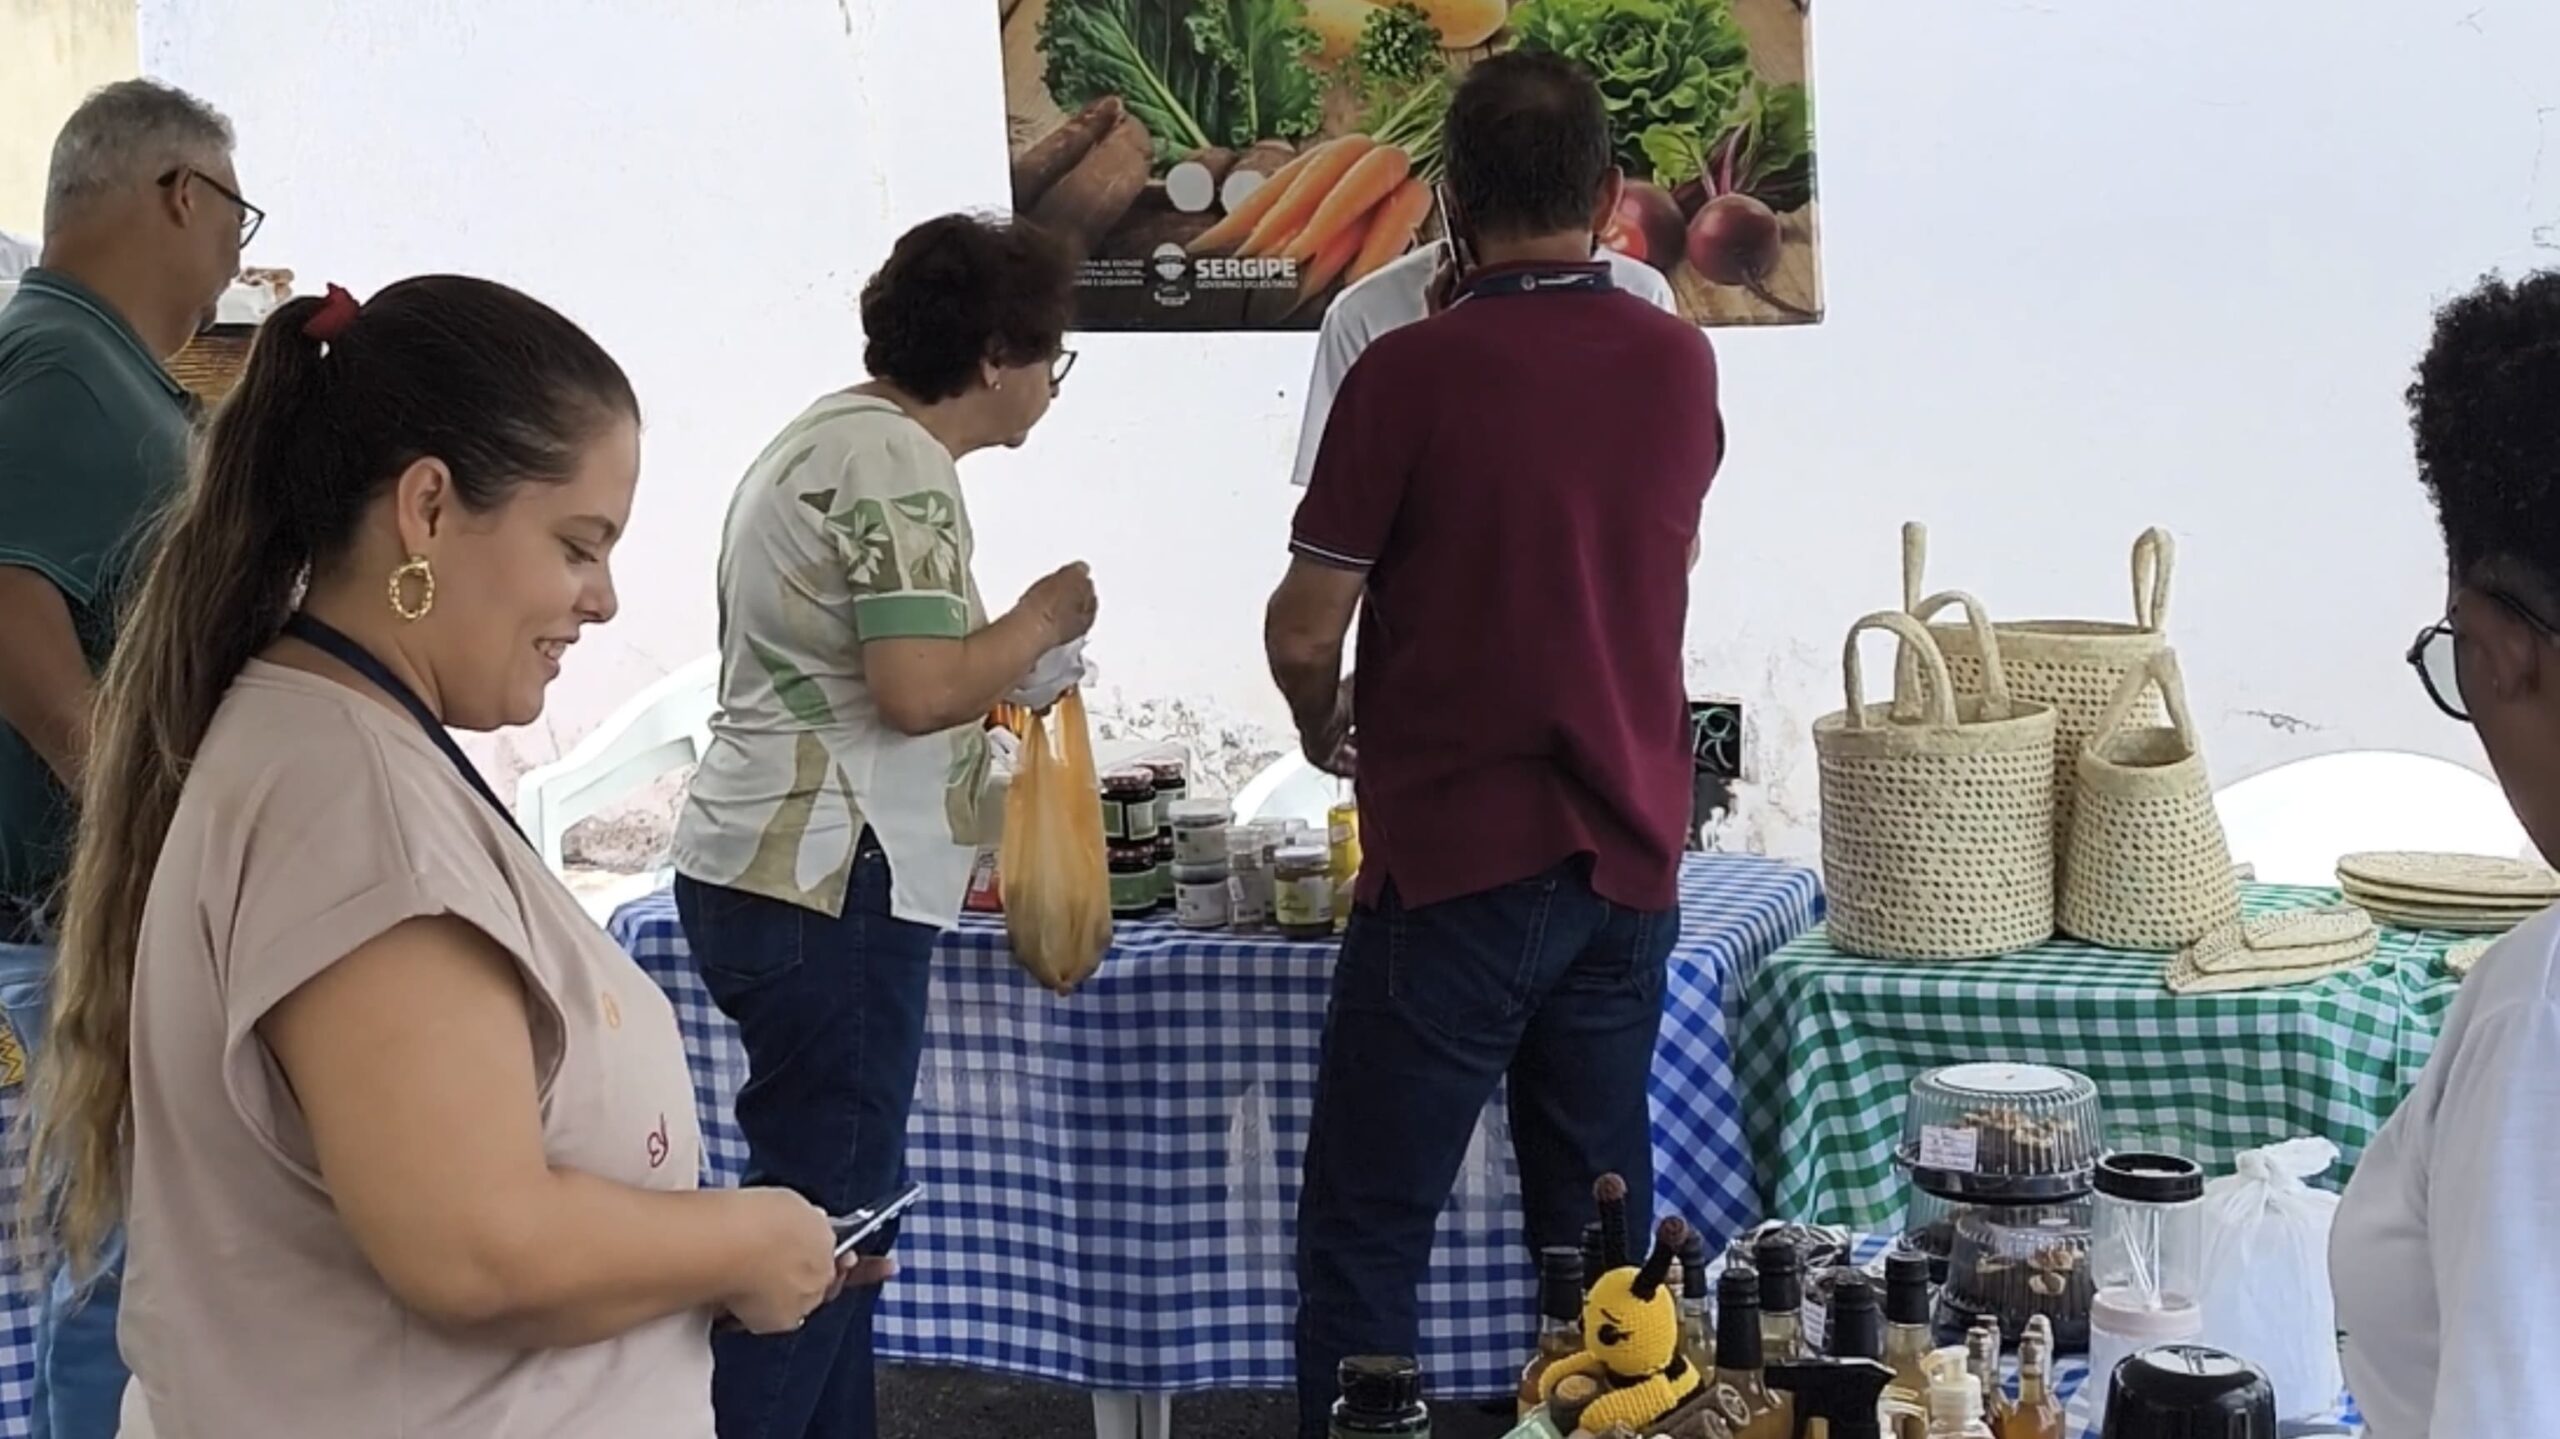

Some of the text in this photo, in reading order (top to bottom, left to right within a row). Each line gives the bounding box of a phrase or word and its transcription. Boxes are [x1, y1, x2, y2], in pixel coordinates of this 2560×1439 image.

[1194, 258, 1297, 278] SERGIPE
[1195, 280, 1298, 289] GOVERNO DO ESTADO
